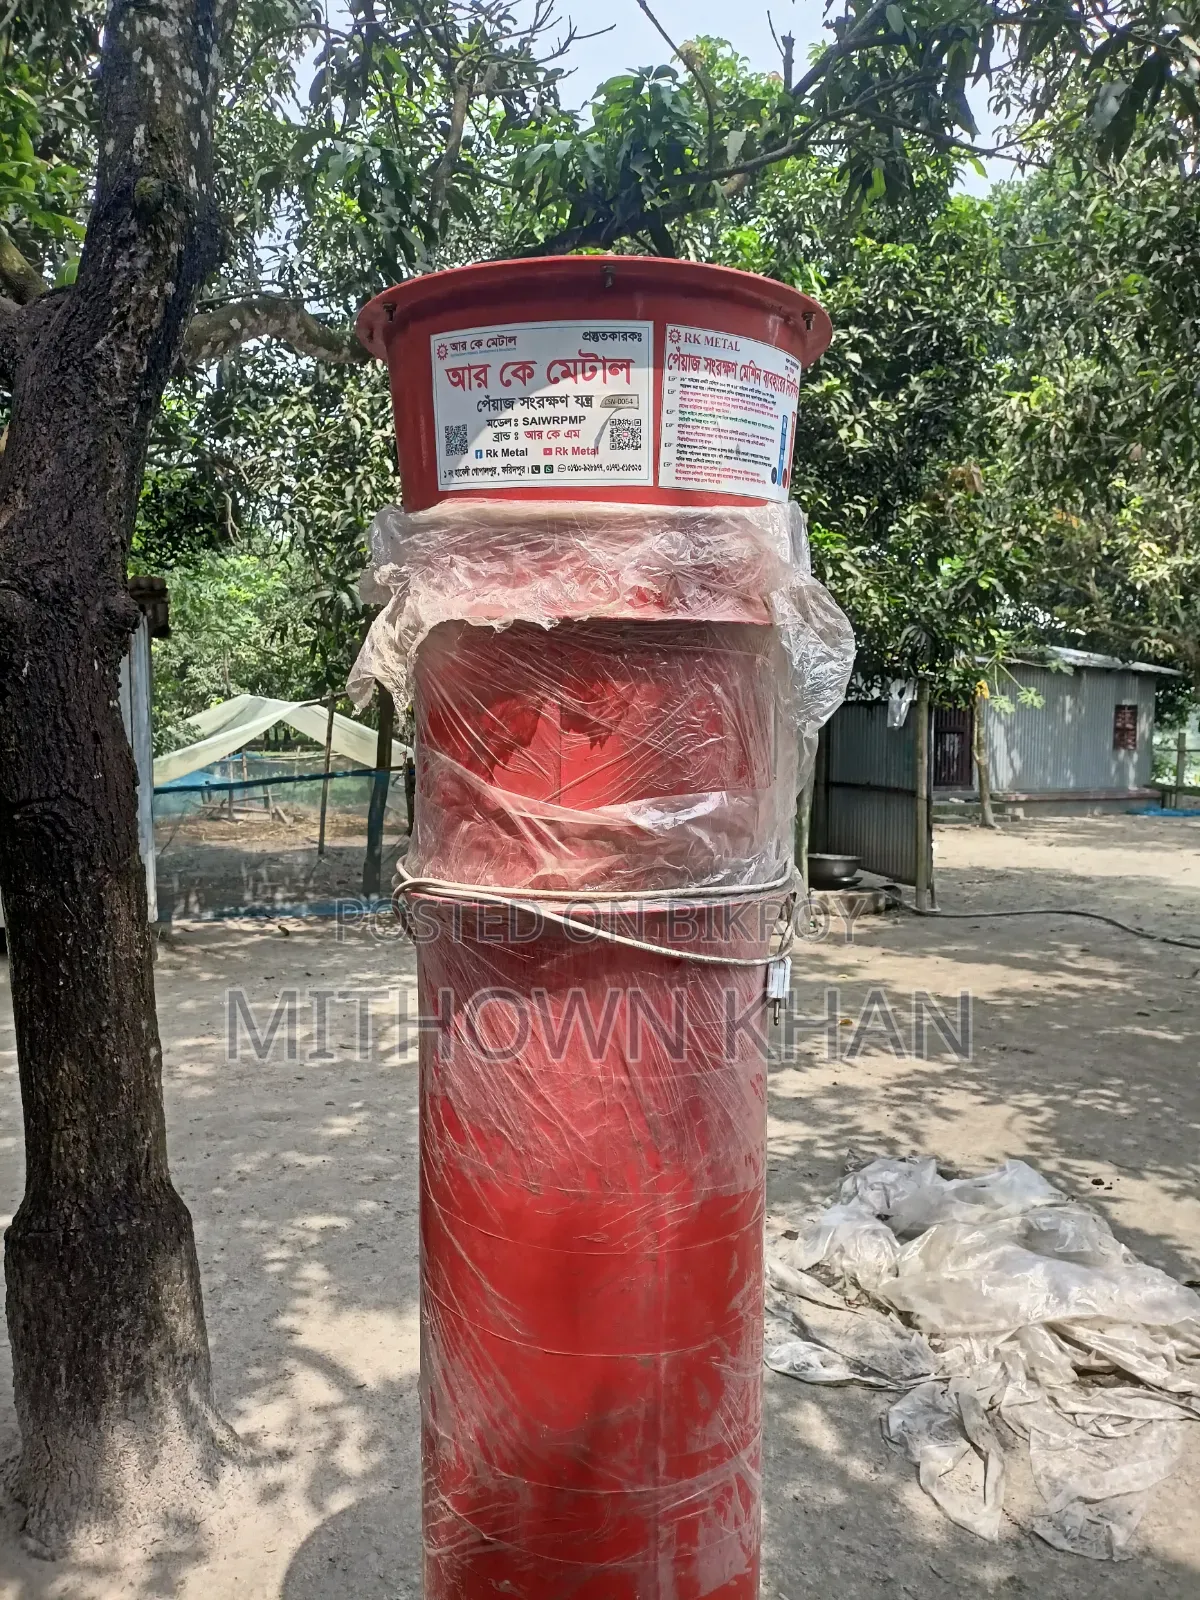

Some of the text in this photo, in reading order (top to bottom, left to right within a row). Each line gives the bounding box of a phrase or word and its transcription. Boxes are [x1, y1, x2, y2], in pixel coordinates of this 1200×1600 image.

[449, 341, 467, 352] আর
[470, 339, 483, 350] কে
[486, 334, 517, 348] মেটাল
[684, 332, 741, 352] RK METAL
[667, 346, 702, 374] পেঁয়াজ
[444, 348, 635, 392] আর কে মেটাল
[476, 394, 594, 412] পেঁয়াজ সংরক্ষণ যন্ত্র
[522, 415, 586, 426] SAIWRPMP
[524, 429, 544, 440] আর
[546, 429, 561, 440] কে
[564, 429, 581, 439] এম
[486, 447, 528, 458] Rk Metal
[555, 445, 600, 456] Rk Metal
